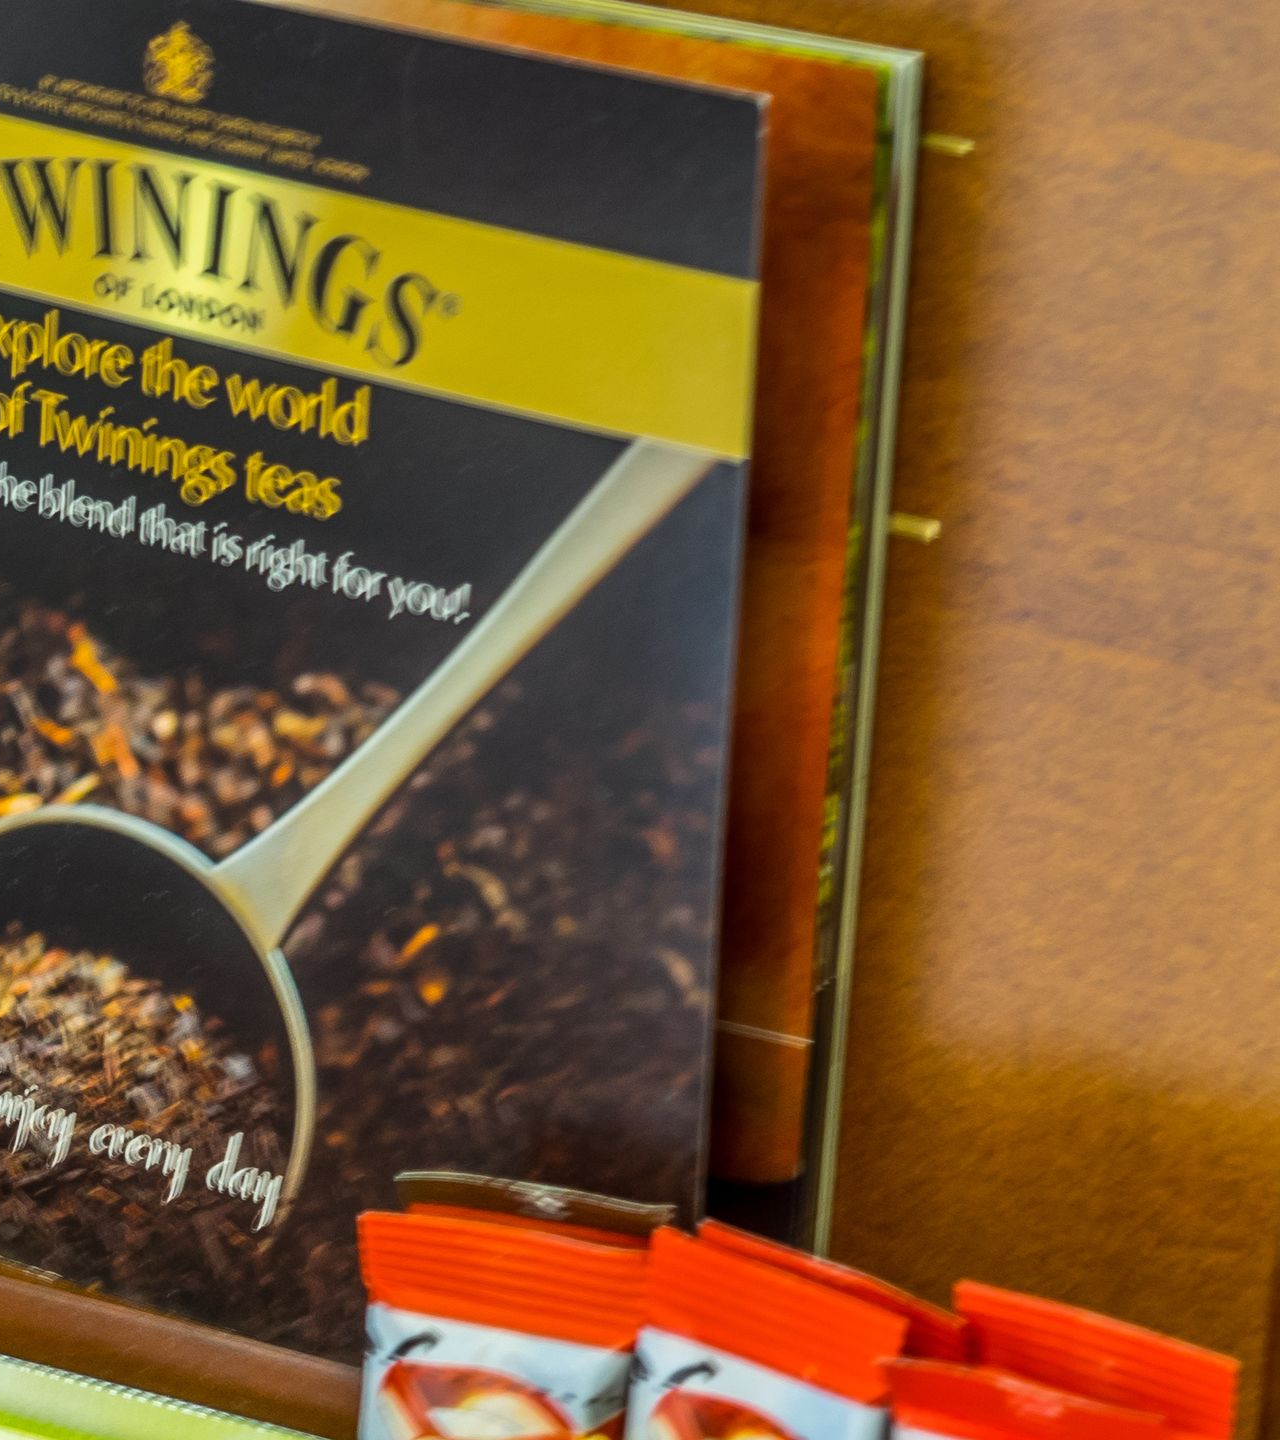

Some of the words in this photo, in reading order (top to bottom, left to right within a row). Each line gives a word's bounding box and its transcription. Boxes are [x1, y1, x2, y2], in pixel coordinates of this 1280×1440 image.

[94, 271, 133, 299] OF
[142, 284, 270, 332] LONDON
[141, 337, 219, 409] the
[226, 378, 372, 446] world
[31, 389, 237, 507] Twinings
[245, 451, 342, 519] teas
[39, 473, 136, 538] blend
[140, 503, 207, 557] that
[212, 522, 242, 566] is
[246, 534, 329, 592] right
[332, 551, 387, 602] for
[89, 1123, 192, 1205] every
[206, 1132, 283, 1233] day
